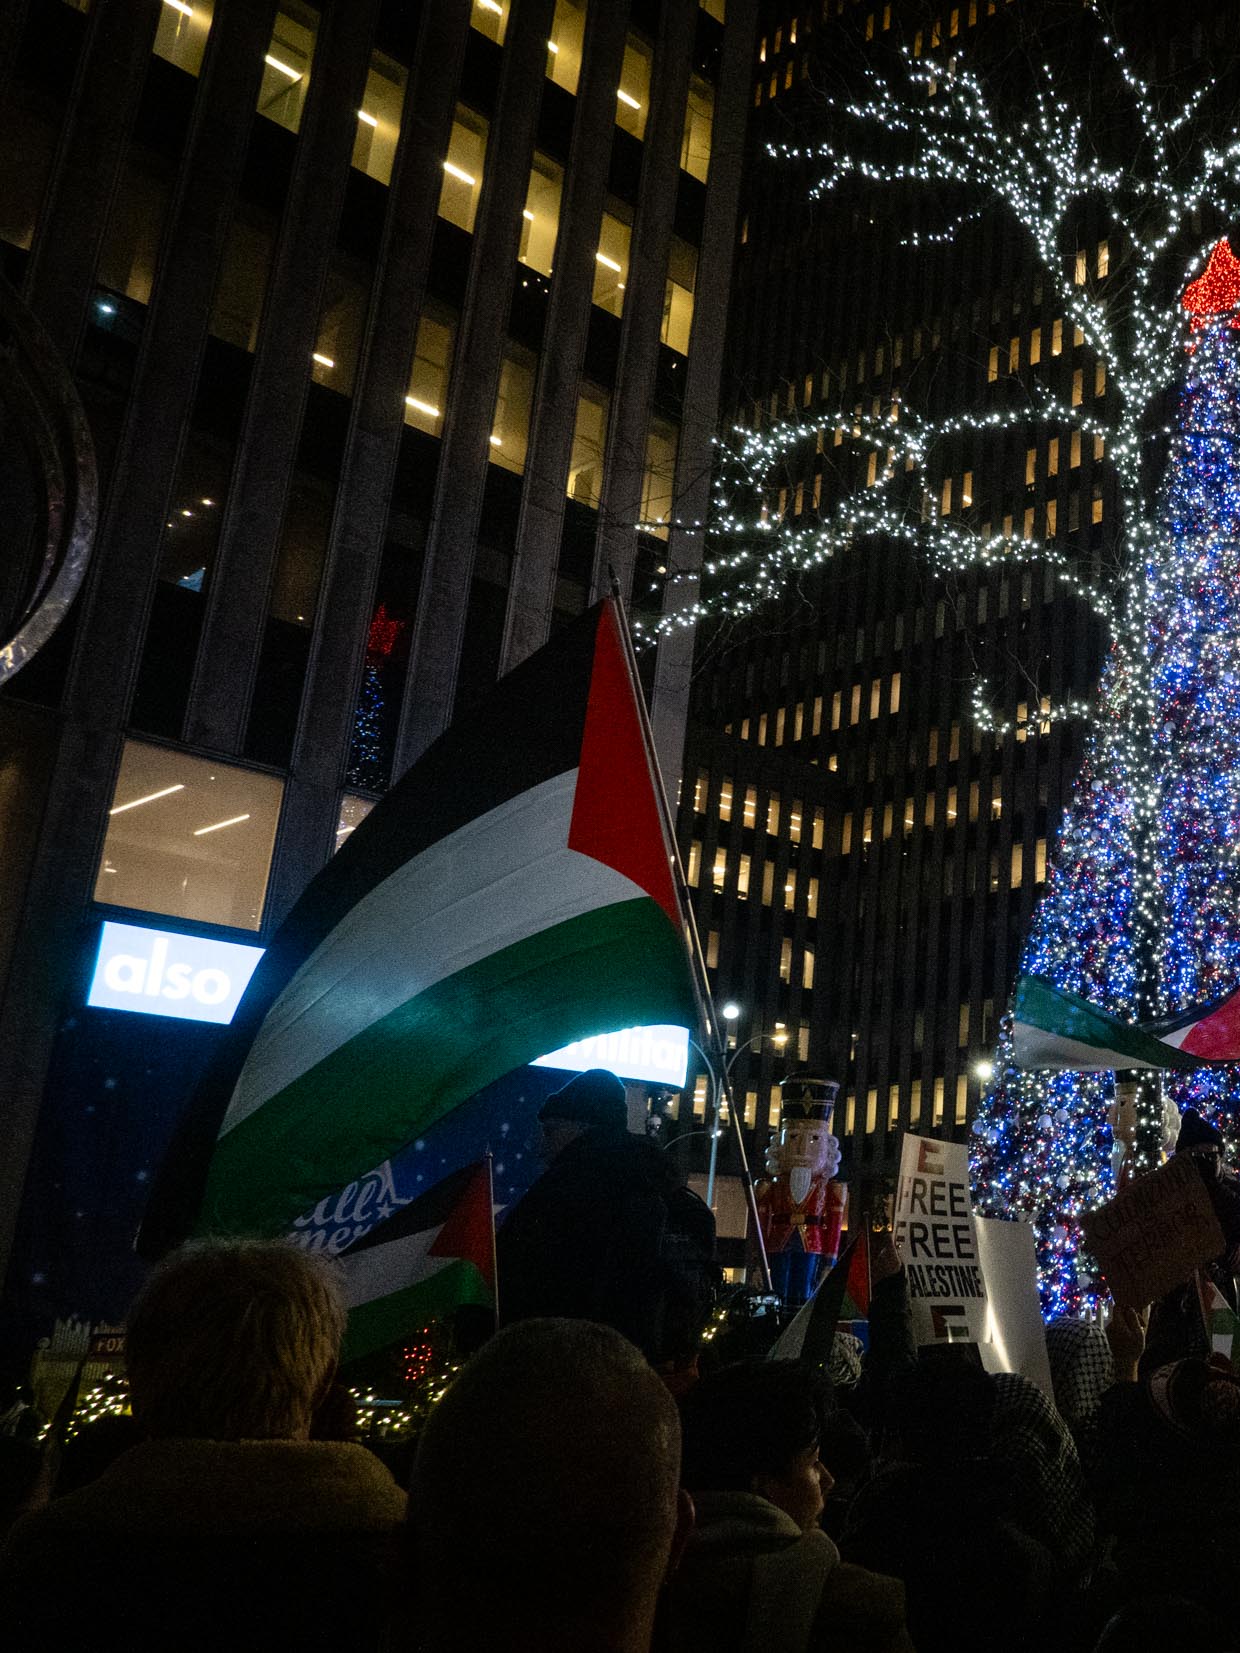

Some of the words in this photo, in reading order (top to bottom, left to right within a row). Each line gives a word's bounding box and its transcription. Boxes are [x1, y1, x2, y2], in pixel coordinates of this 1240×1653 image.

[104, 937, 231, 1005] also
[898, 1176, 968, 1217] FREE
[895, 1221, 974, 1259] FREE
[907, 1264, 984, 1298] ALESTINE
[96, 1336, 125, 1353] FOX
